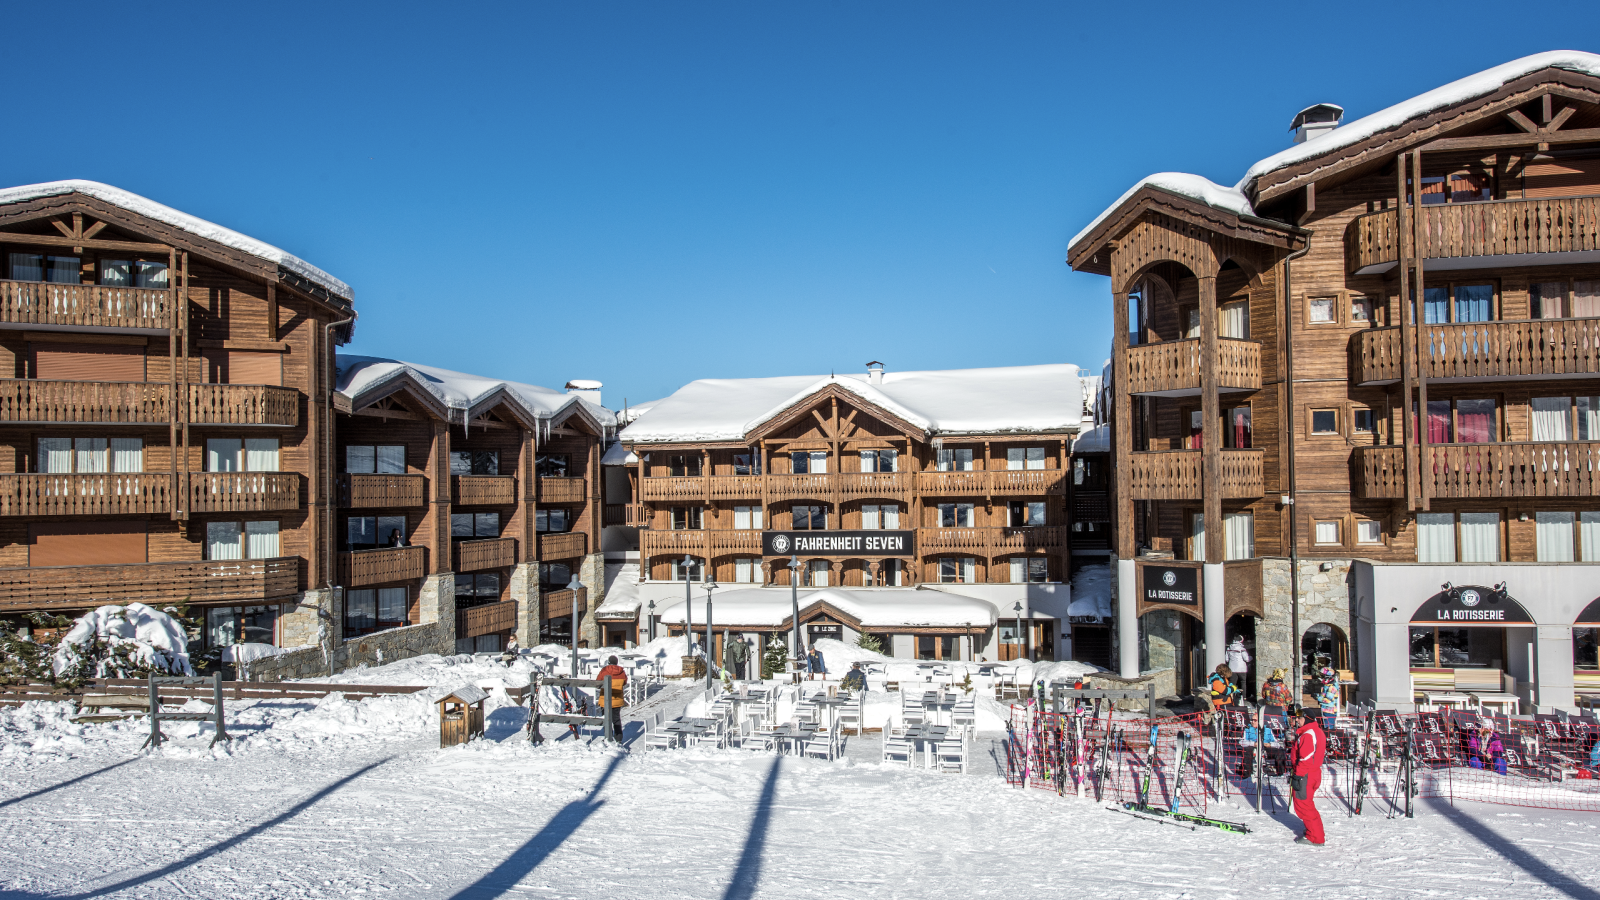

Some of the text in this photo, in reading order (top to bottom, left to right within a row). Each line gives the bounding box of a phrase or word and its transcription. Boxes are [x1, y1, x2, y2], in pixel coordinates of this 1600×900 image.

[795, 536, 862, 550] FAHRENHEIT
[866, 536, 903, 550] SEVEN
[1148, 590, 1192, 601] LA ROTISSERIE
[1438, 610, 1504, 620] LA ROTISSERIE
